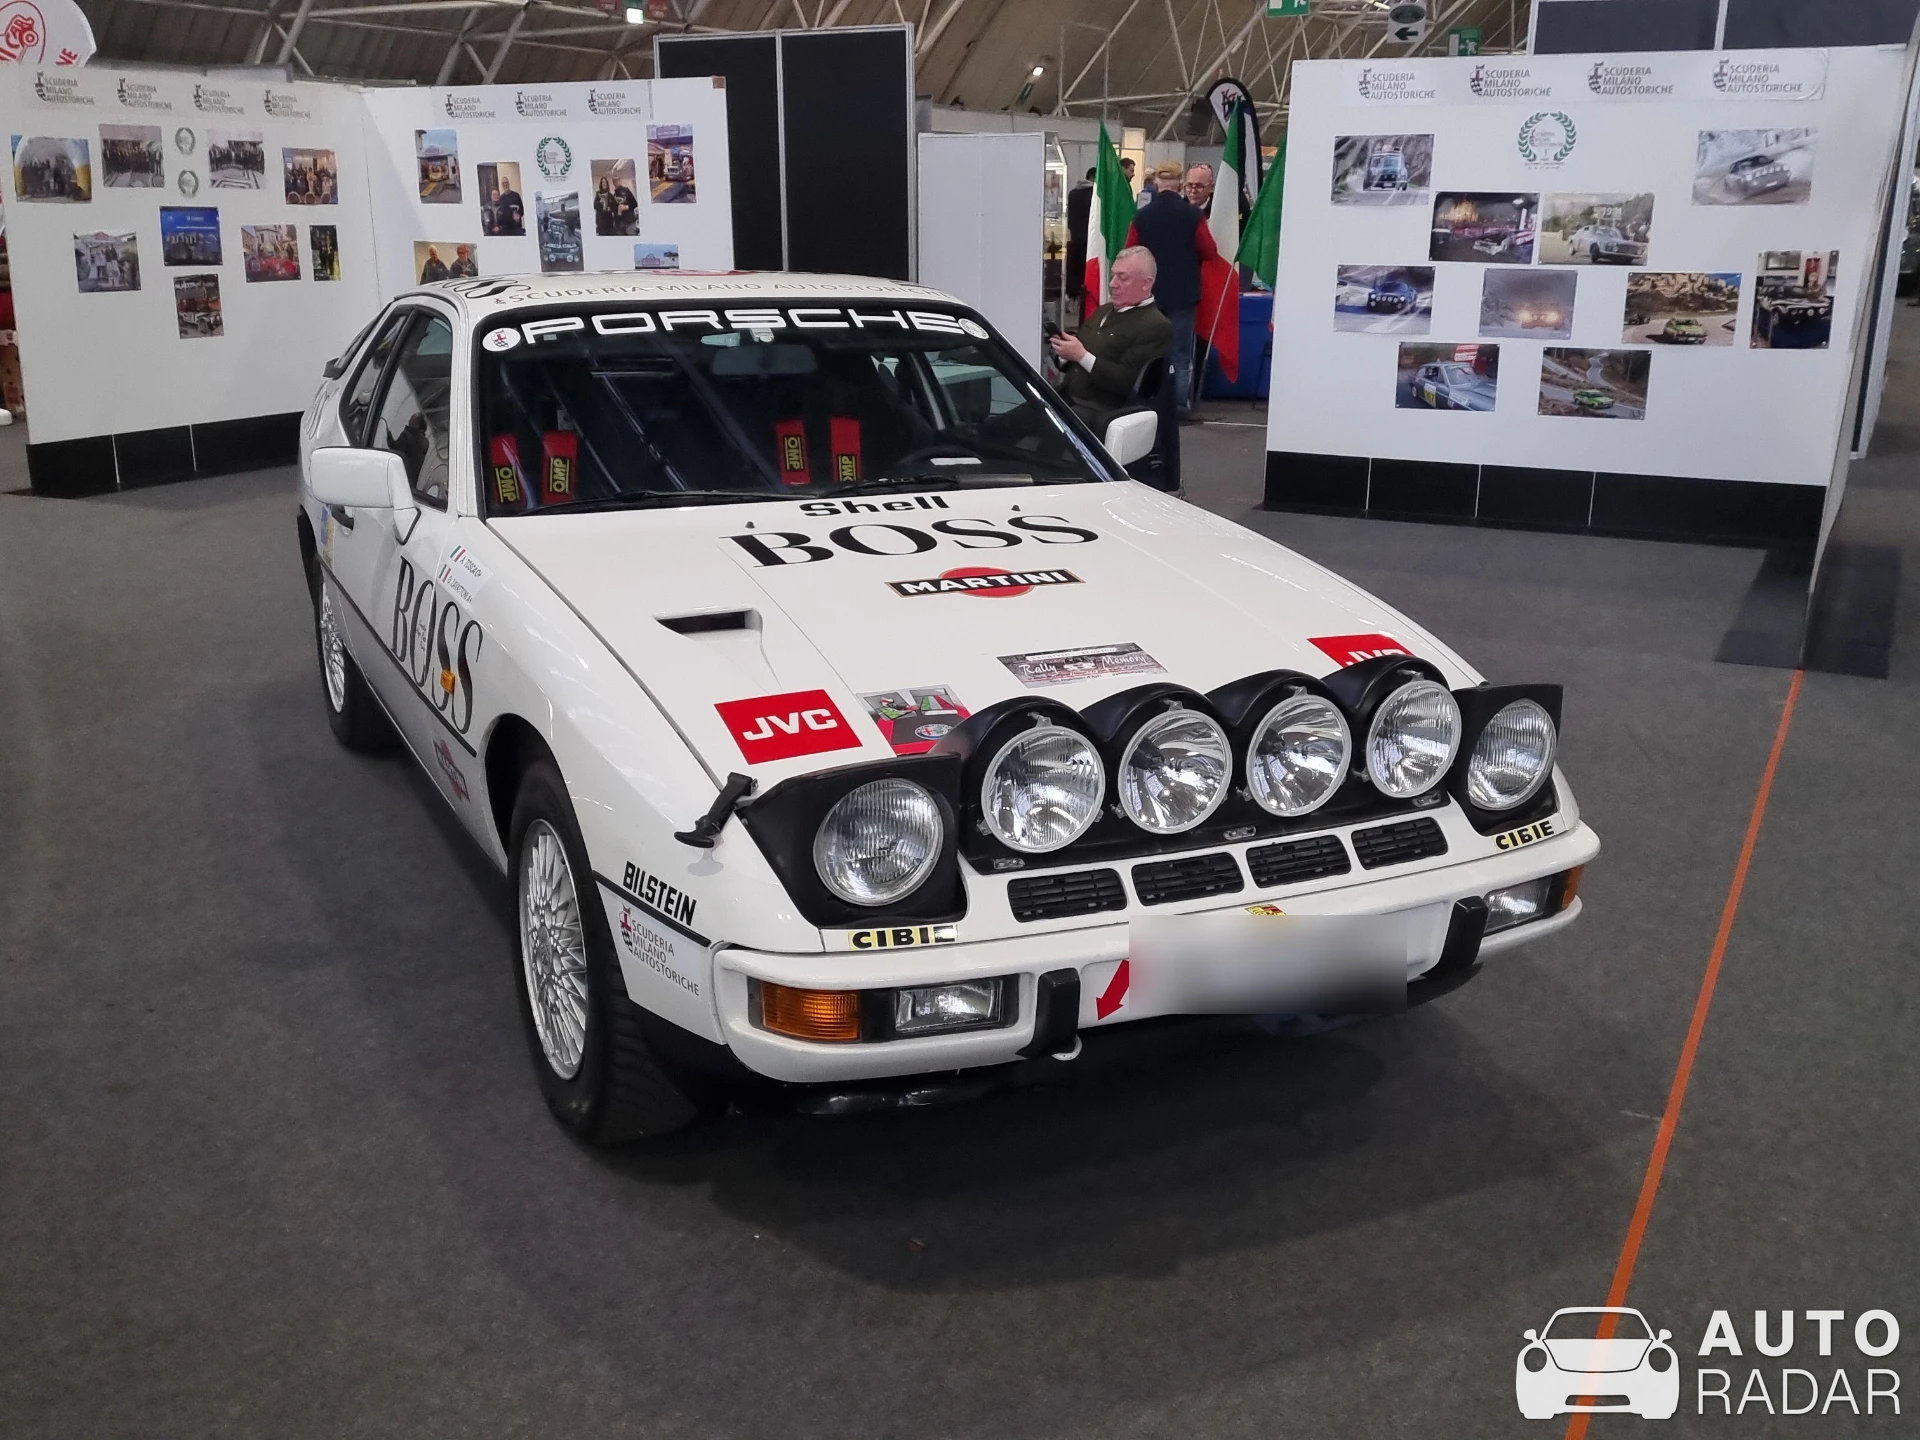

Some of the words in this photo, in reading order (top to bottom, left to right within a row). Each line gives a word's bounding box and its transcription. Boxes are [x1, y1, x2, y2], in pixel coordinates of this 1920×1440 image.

[1372, 72, 1415, 82] SCUDERIA
[1485, 69, 1530, 79] SCUDERIA
[1603, 76, 1641, 85] MILANO
[1604, 66, 1652, 76] SCUDERIA
[1729, 74, 1768, 83] MILANO
[1730, 64, 1779, 73] SCUDERIA
[1370, 90, 1436, 99] AUTOSTORICHE
[1371, 82, 1406, 90] MILANO
[1483, 87, 1551, 97] AUTOSTORICHE
[1484, 79, 1520, 88] MILANO
[509, 284, 646, 303] SCUDERIA
[655, 283, 763, 293] MILANO
[521, 309, 965, 344] PORSCHE
[788, 436, 800, 470] OMP
[500, 467, 516, 502] OMP
[552, 458, 567, 493] OMP
[799, 495, 951, 517] Shell
[719, 515, 1099, 568] BOSS
[903, 570, 1068, 596] MARTINI
[391, 555, 484, 735] BOSS
[1018, 663, 1060, 677] Rally
[1101, 655, 1149, 669] Memory
[742, 708, 838, 741] JVC
[1495, 820, 1555, 850] CIBIE
[622, 860, 698, 927] BILSTEIN
[631, 919, 676, 957] SCUDERIA
[632, 932, 667, 964] MILANO
[633, 946, 701, 998] AUTOSTORICHE
